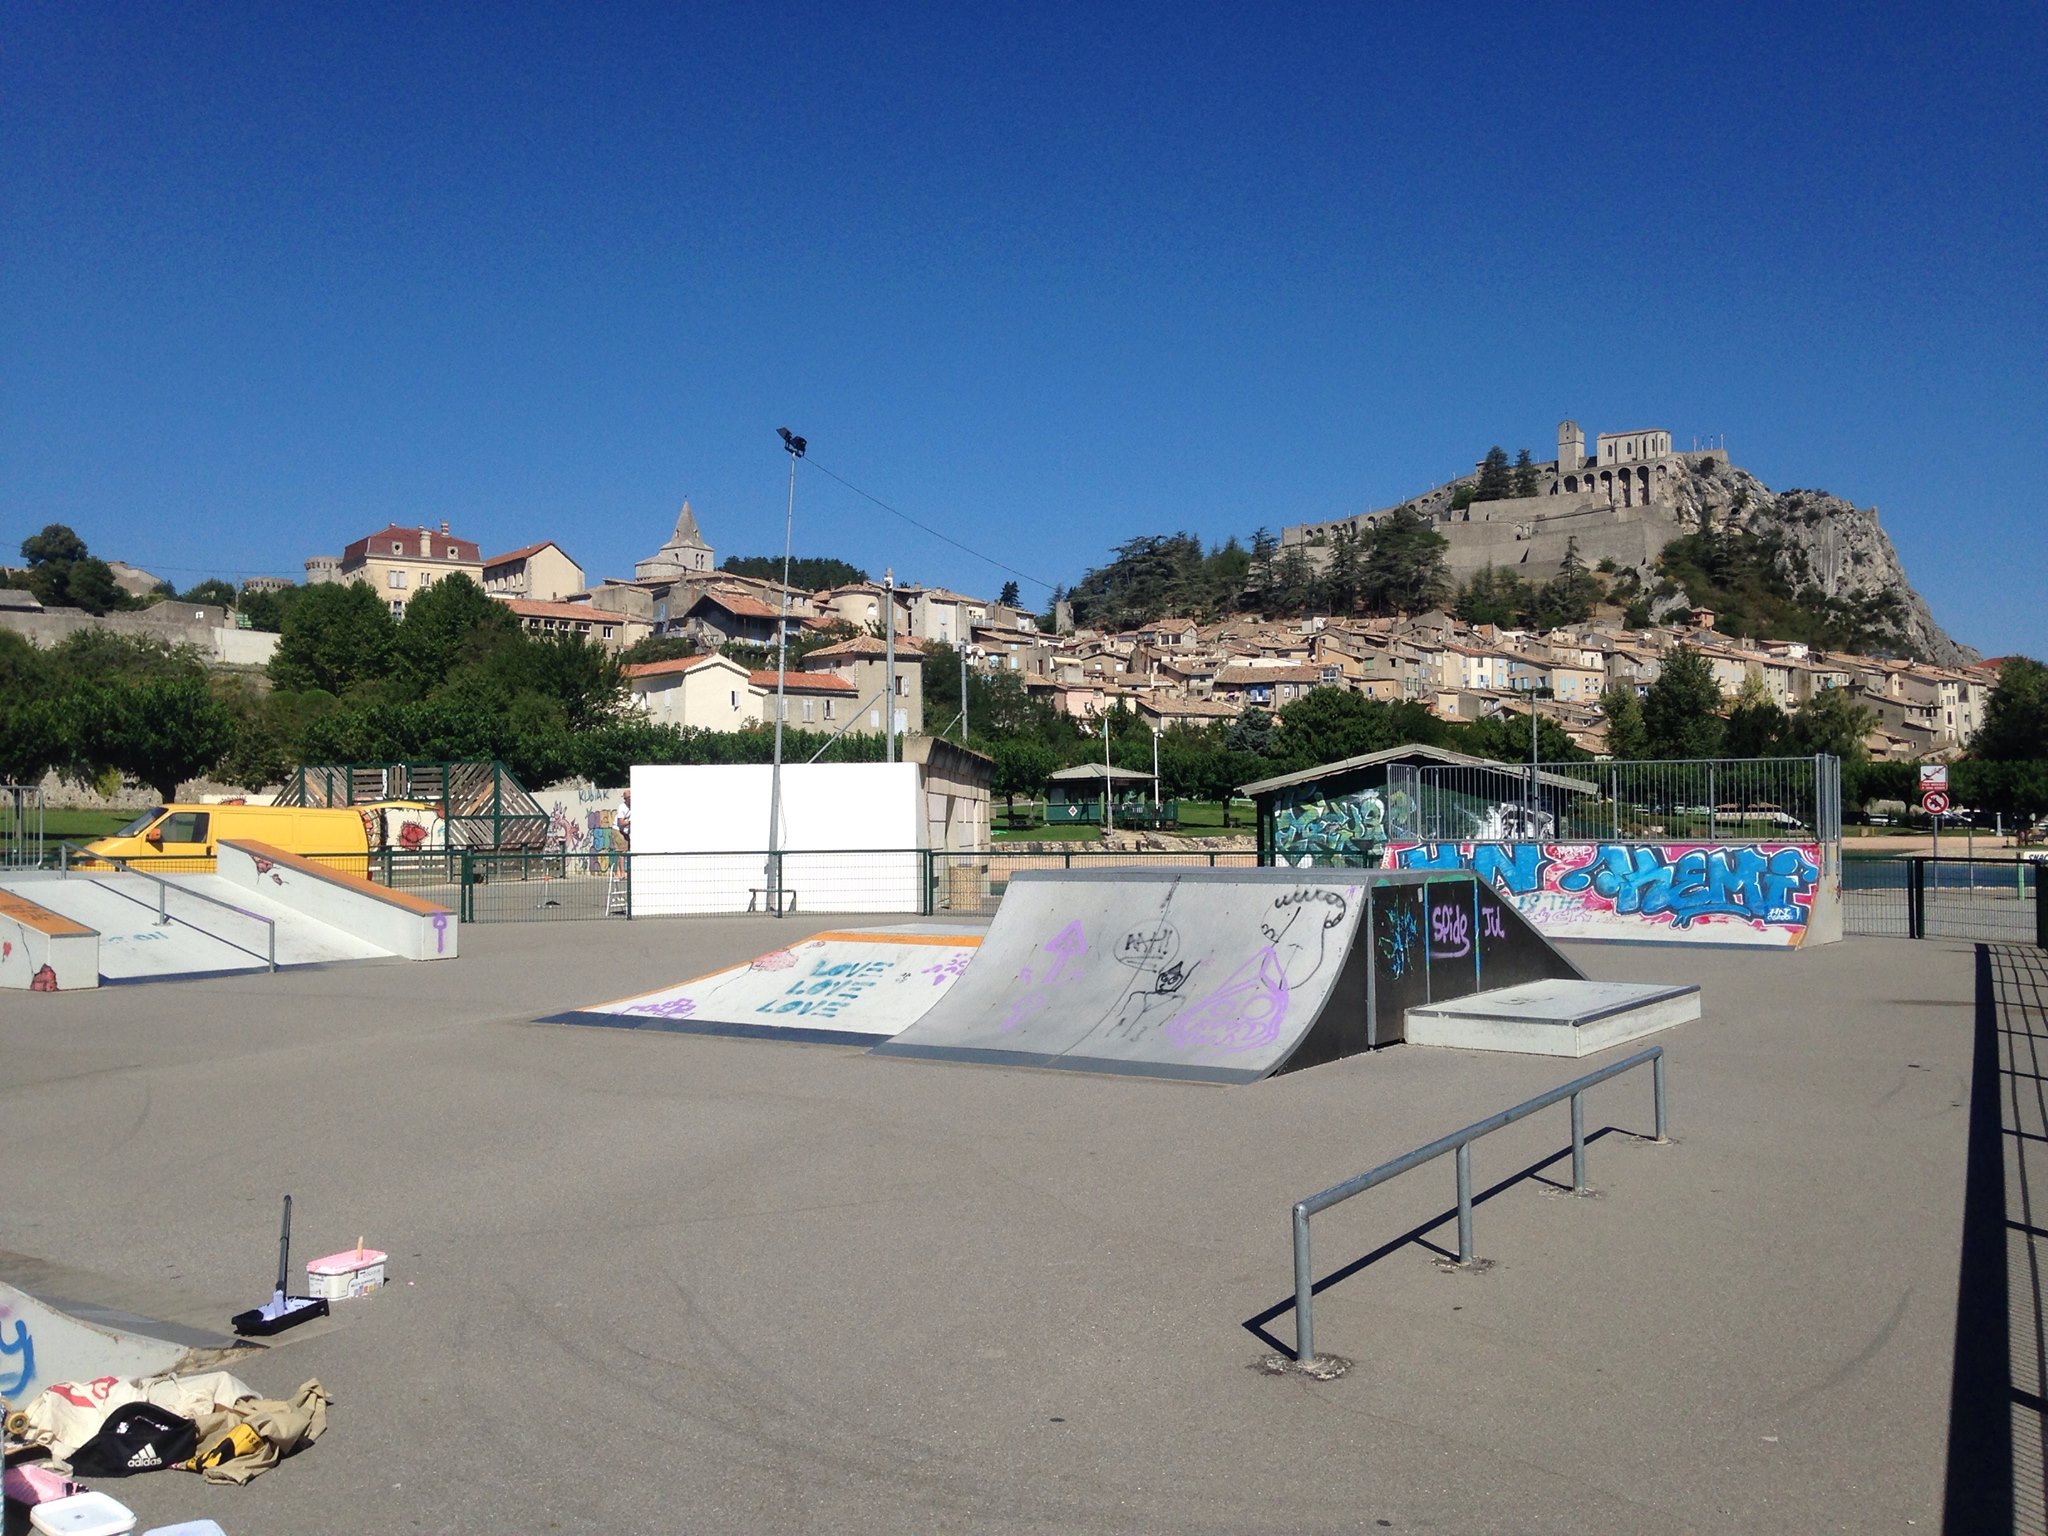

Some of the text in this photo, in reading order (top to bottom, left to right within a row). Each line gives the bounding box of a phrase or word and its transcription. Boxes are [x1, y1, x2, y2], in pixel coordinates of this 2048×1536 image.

[810, 959, 895, 978] LOVE
[785, 979, 877, 999] LOVE
[755, 999, 851, 1018] LOVE
[127, 1456, 162, 1468] adidas
